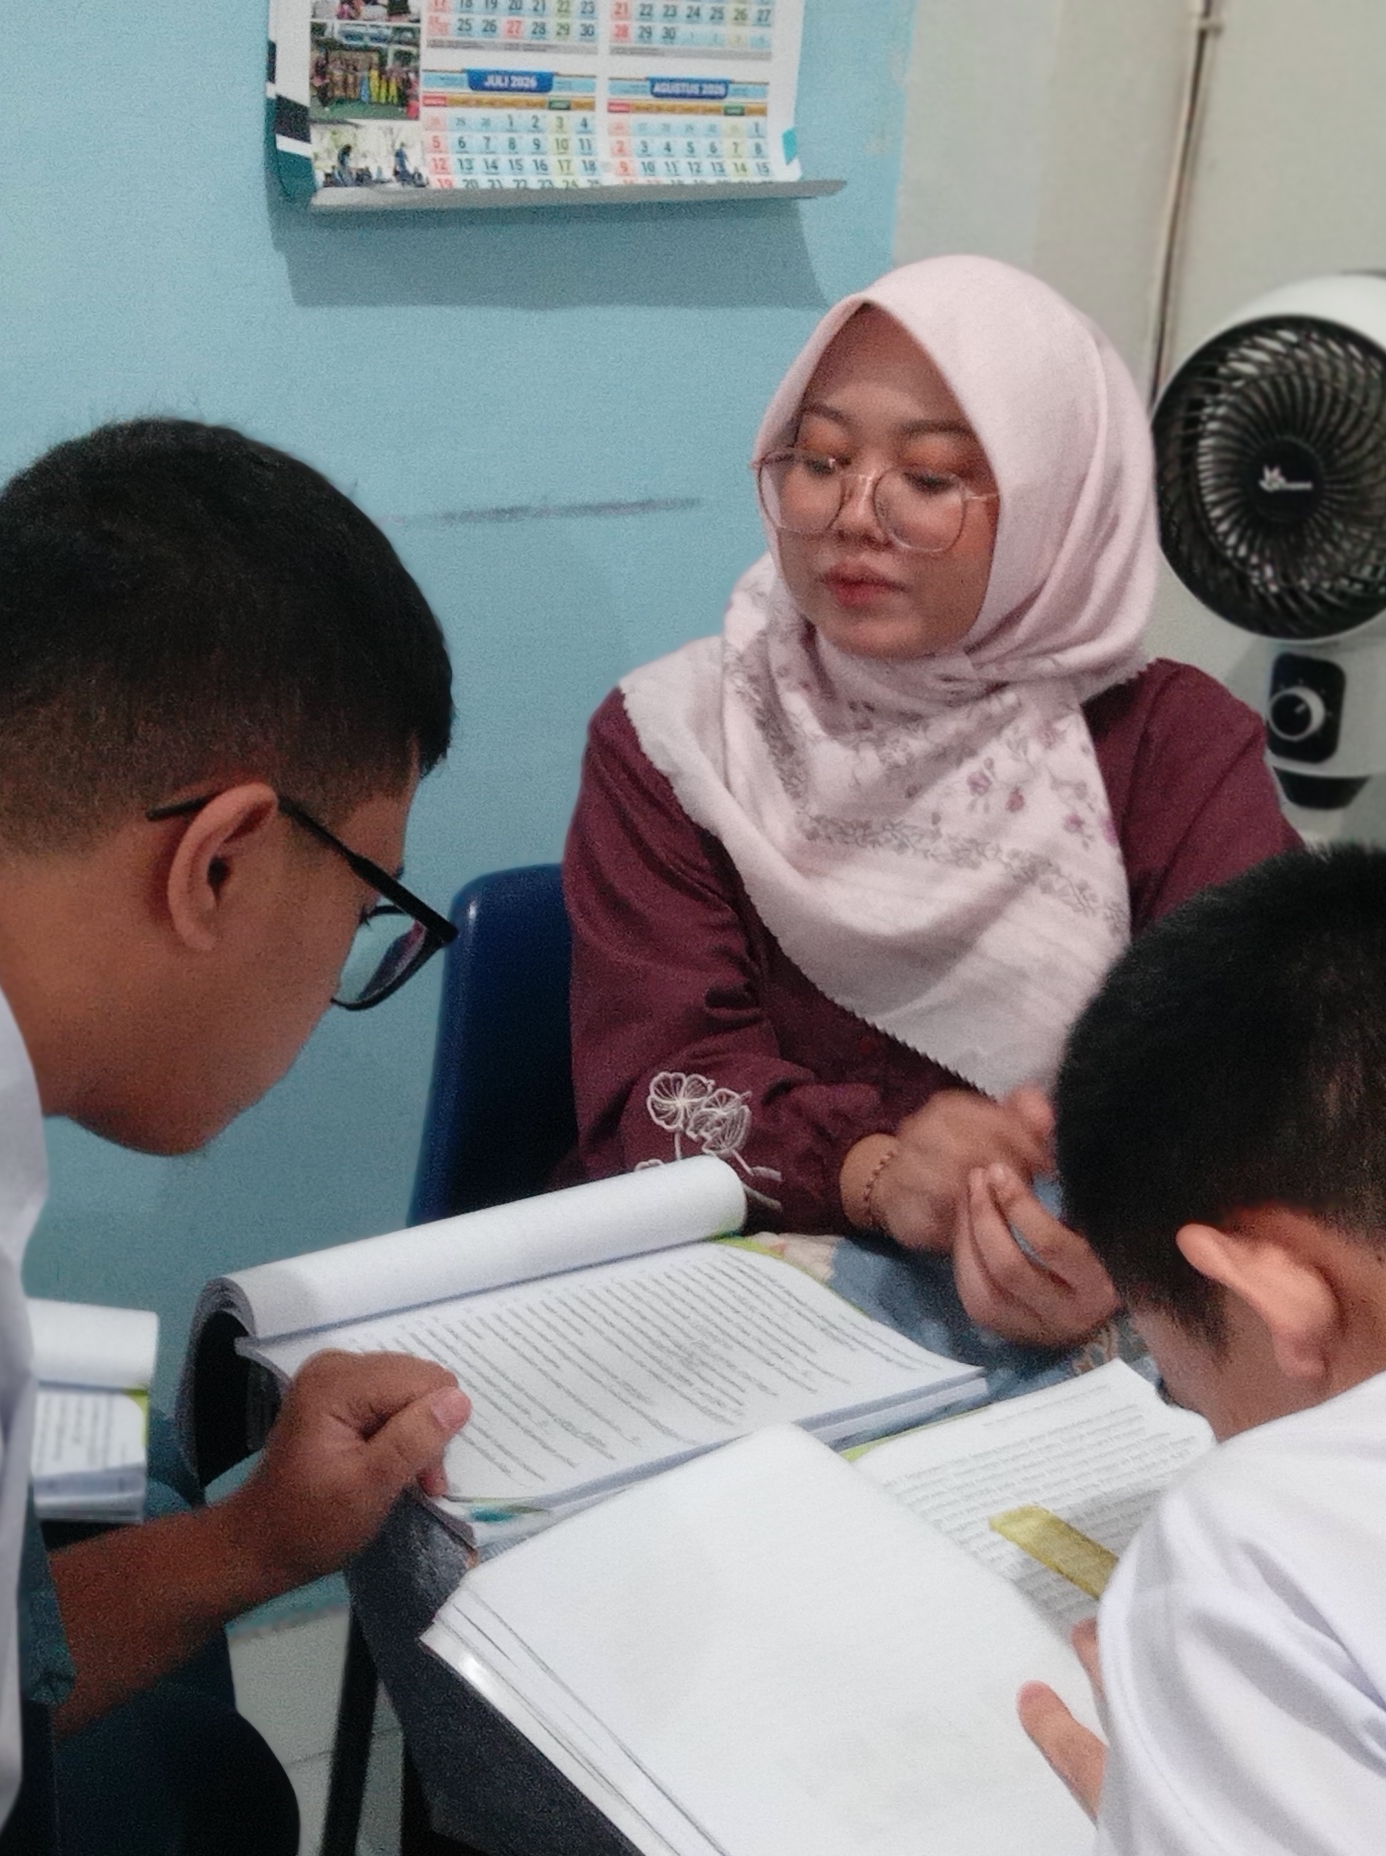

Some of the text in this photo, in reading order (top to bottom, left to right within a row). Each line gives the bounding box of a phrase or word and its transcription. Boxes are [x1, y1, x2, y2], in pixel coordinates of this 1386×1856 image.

[533, 0, 546, 12] 21
[557, 0, 571, 13] 22
[581, 1, 595, 14] 23
[615, 2, 772, 22] 21 22 23 24 25 26 27
[458, 18, 473, 31] 25
[482, 19, 497, 32] 26
[507, 20, 521, 34] 27
[532, 22, 546, 35] 28
[556, 22, 570, 36] 29
[580, 24, 595, 37] 30
[615, 25, 629, 38] 28
[639, 26, 653, 39] 29
[663, 27, 677, 39] 30
[484, 76, 538, 89] JULI 2026
[654, 82, 699, 94] AGUSTUS
[508, 115, 513, 127] 1
[531, 115, 540, 129] 2
[556, 116, 563, 129] 3
[580, 117, 588, 128] 4
[433, 136, 592, 150] 5 6 7 8 9 10 11
[616, 140, 762, 154] 2 3 4 5 6 7 8
[433, 159, 596, 172] 12 13 14 15 16 17 18
[619, 161, 770, 174] 9 10 11 12 13 14 15
[463, 179, 479, 189] 20
